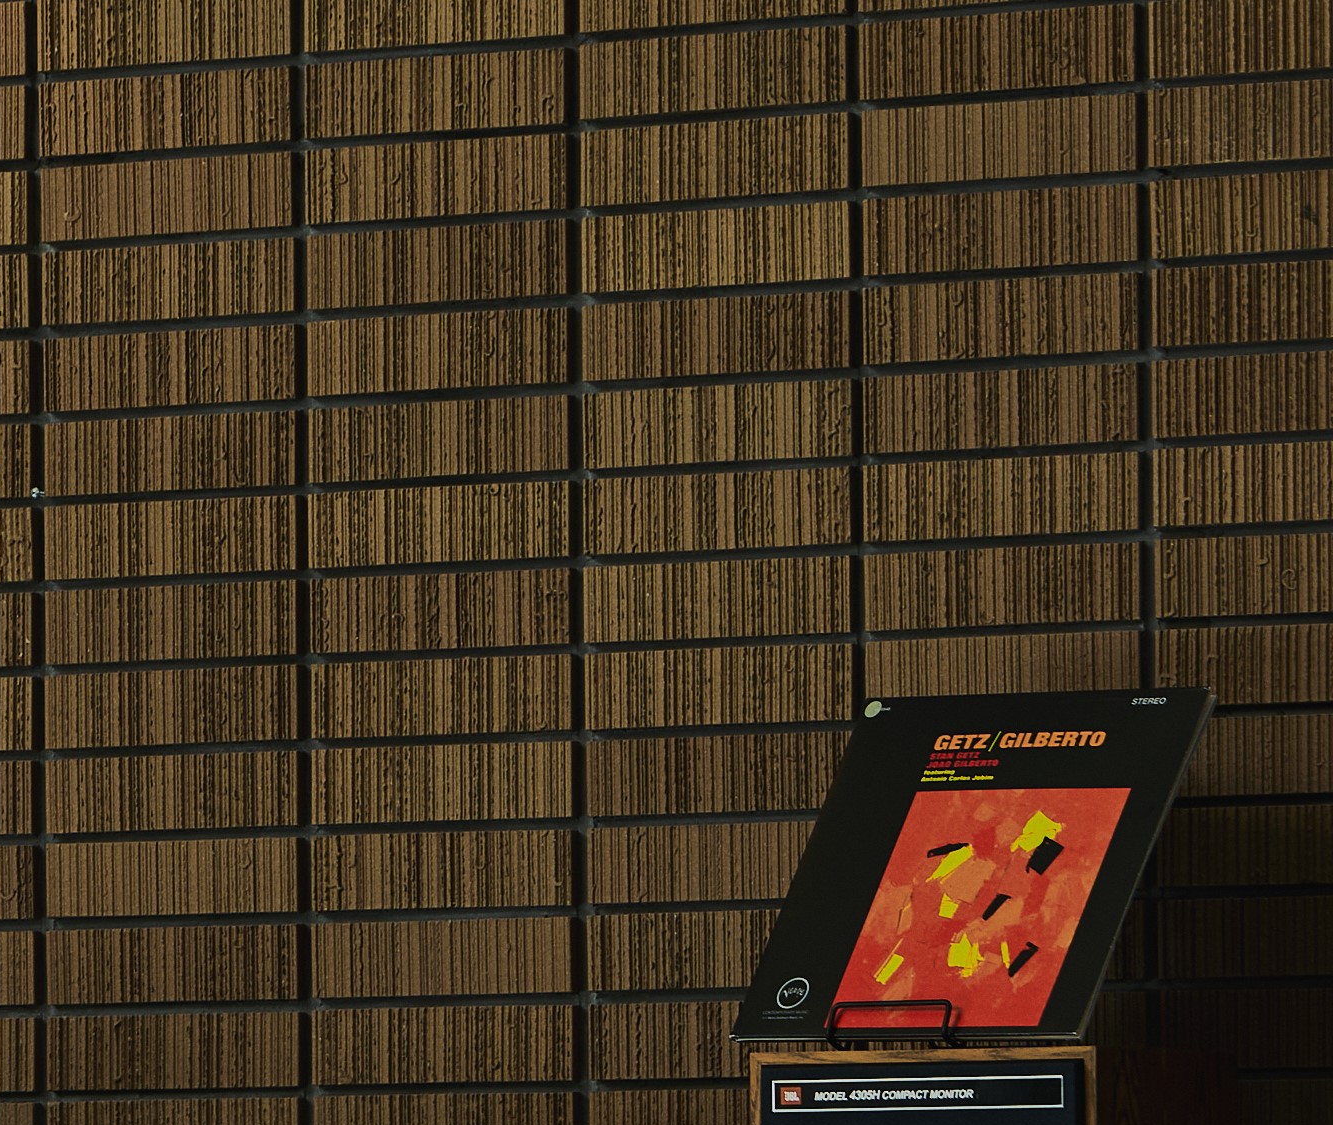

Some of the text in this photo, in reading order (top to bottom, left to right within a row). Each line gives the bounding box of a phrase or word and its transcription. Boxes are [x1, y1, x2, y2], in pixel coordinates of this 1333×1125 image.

[1131, 697, 1167, 705] STEREO
[784, 1089, 974, 1101] JBL MODEL 4305H COMPACT MONITOR
